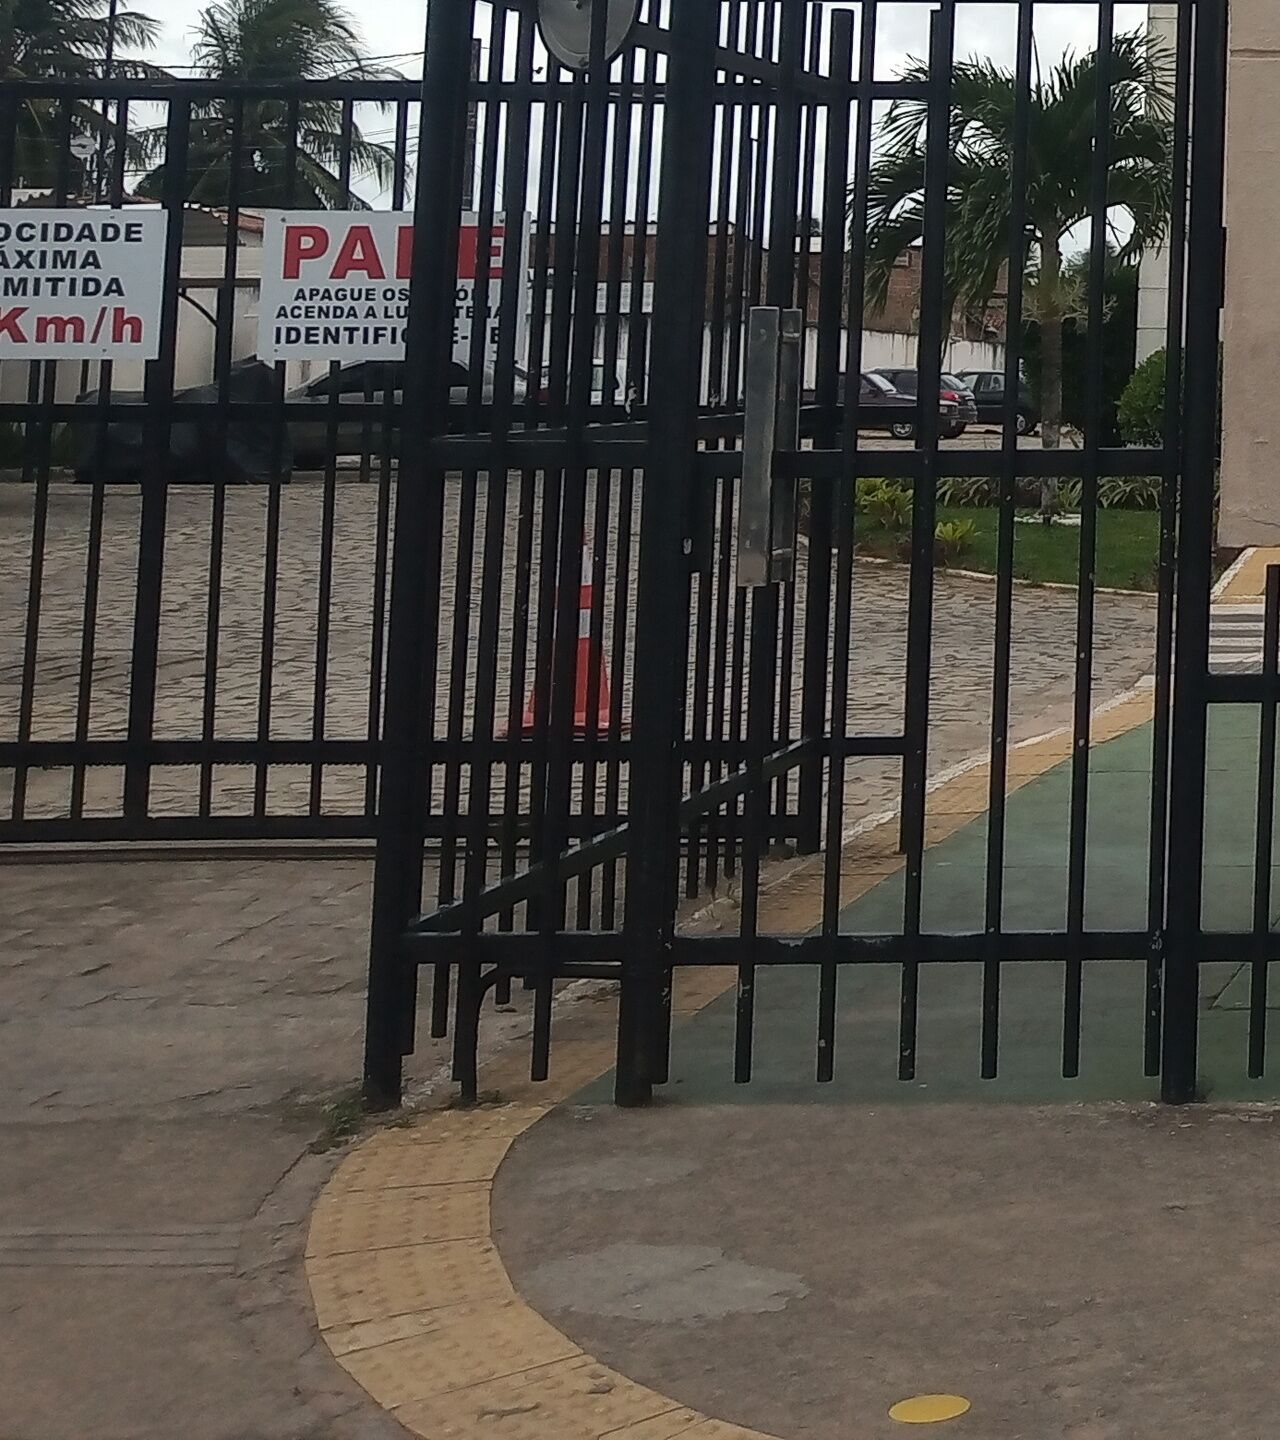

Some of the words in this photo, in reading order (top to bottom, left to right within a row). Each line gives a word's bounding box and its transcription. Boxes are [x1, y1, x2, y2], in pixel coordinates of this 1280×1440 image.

[293, 287, 377, 302] APAGUE
[382, 287, 410, 302] OS
[275, 305, 359, 319] ACENDA
[363, 305, 378, 319] A
